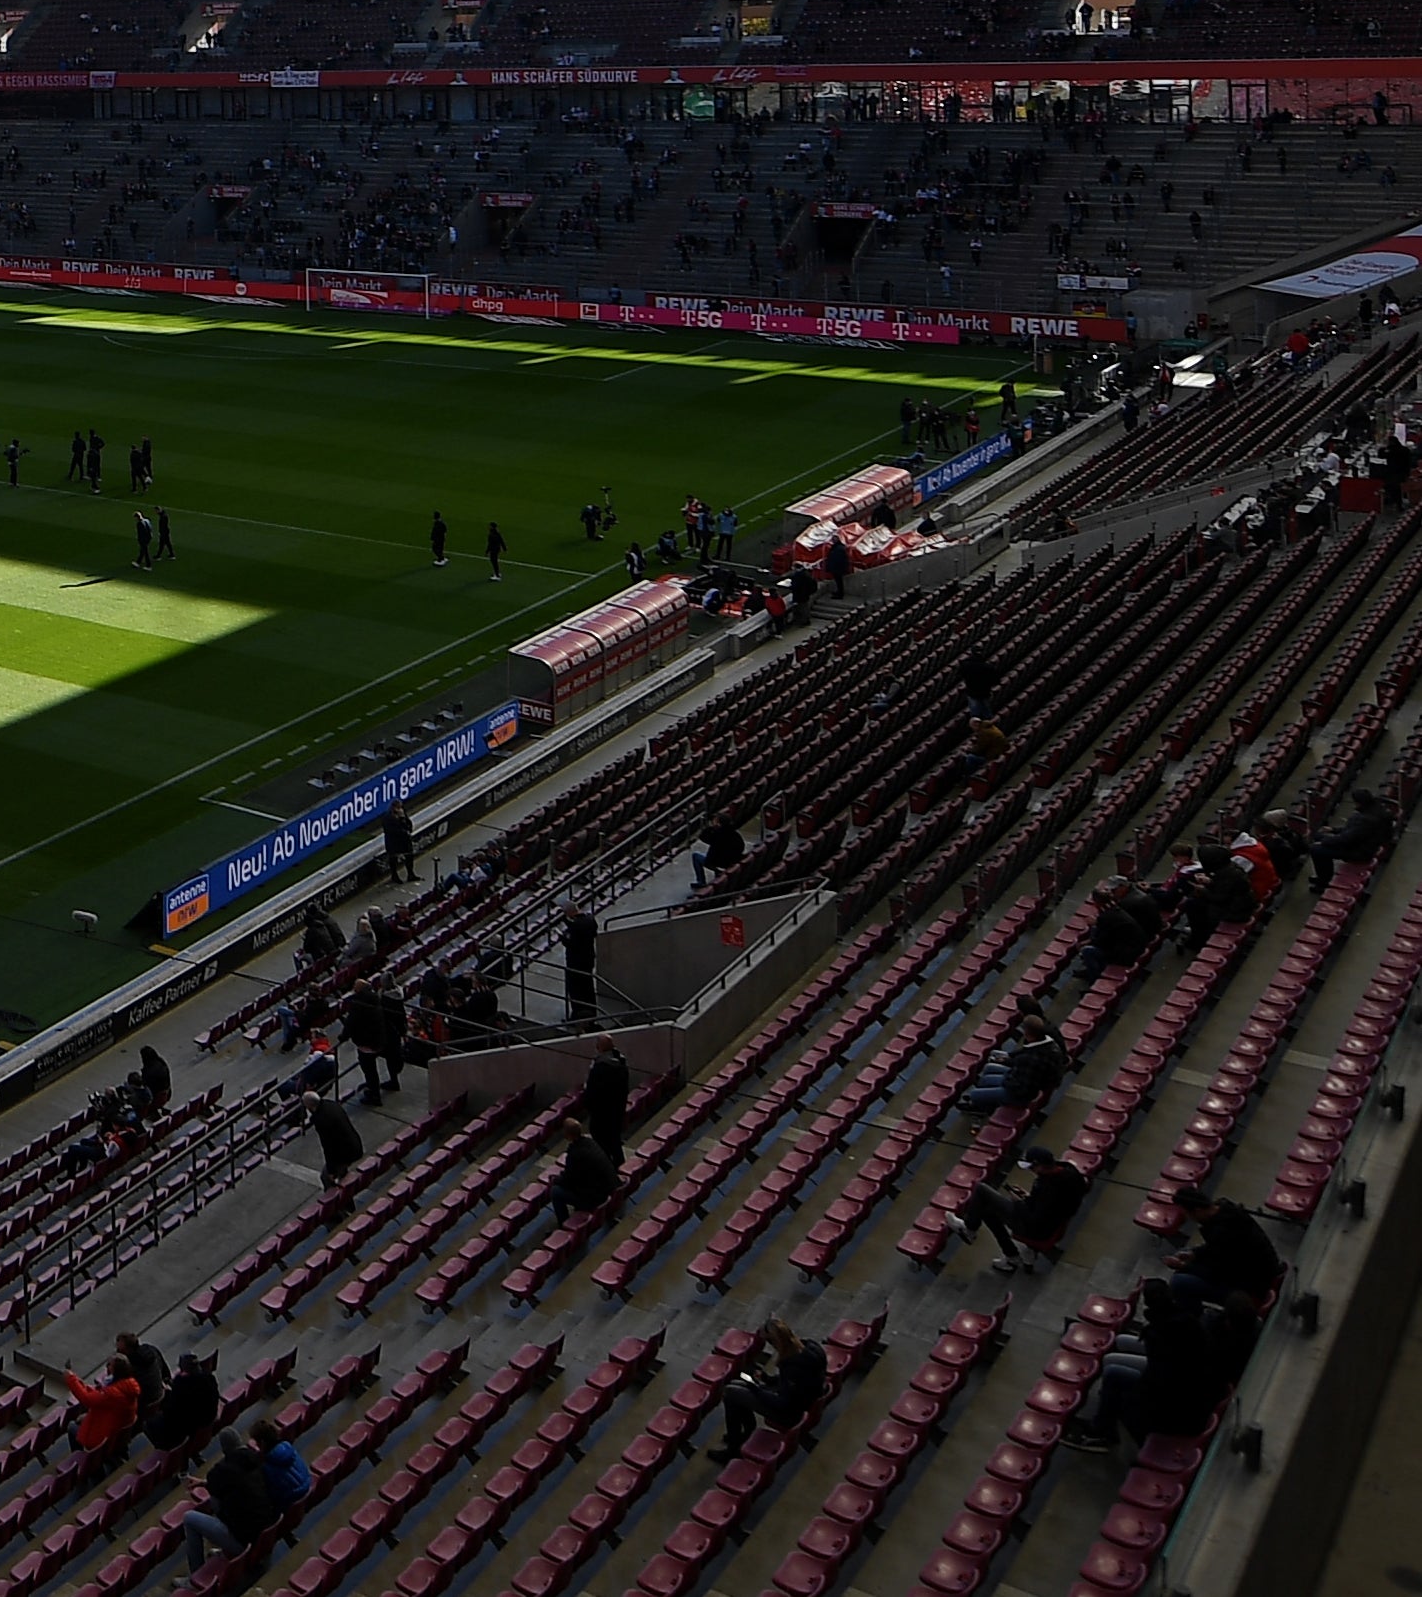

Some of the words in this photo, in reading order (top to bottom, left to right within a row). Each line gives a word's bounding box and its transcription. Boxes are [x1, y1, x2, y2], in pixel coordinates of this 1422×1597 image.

[6, 75, 34, 87] GEGEN
[36, 75, 87, 86] RASSISMUS
[492, 72, 519, 83] HANS
[523, 67, 574, 83] SCHÄFER
[577, 67, 638, 82] SÜDKURVE
[105, 264, 127, 275] Dein
[131, 265, 160, 277] Markt
[174, 268, 214, 280] REWE
[430, 283, 477, 296] REWE
[486, 286, 514, 298] Dein
[519, 289, 559, 302] Markt
[472, 298, 503, 312] dhpg
[655, 297, 710, 310] REWE
[751, 303, 804, 319] Markt
[825, 306, 885, 322] REWE
[938, 313, 989, 331] Markt
[1011, 317, 1079, 337] REWE
[697, 311, 722, 328] 5G
[835, 319, 861, 339] 5G
[229, 848, 266, 890] Neu!
[273, 820, 294, 865] Ab
[300, 782, 377, 853] November
[380, 770, 396, 802] in
[399, 749, 433, 799] ganz
[437, 727, 474, 779] NRW!
[166, 879, 209, 908] antenne
[176, 899, 203, 923] nrw
[253, 931, 270, 949] Mer
[324, 889, 333, 906] FC
[128, 995, 162, 1028] Kaffee
[164, 974, 200, 1005] Partner
